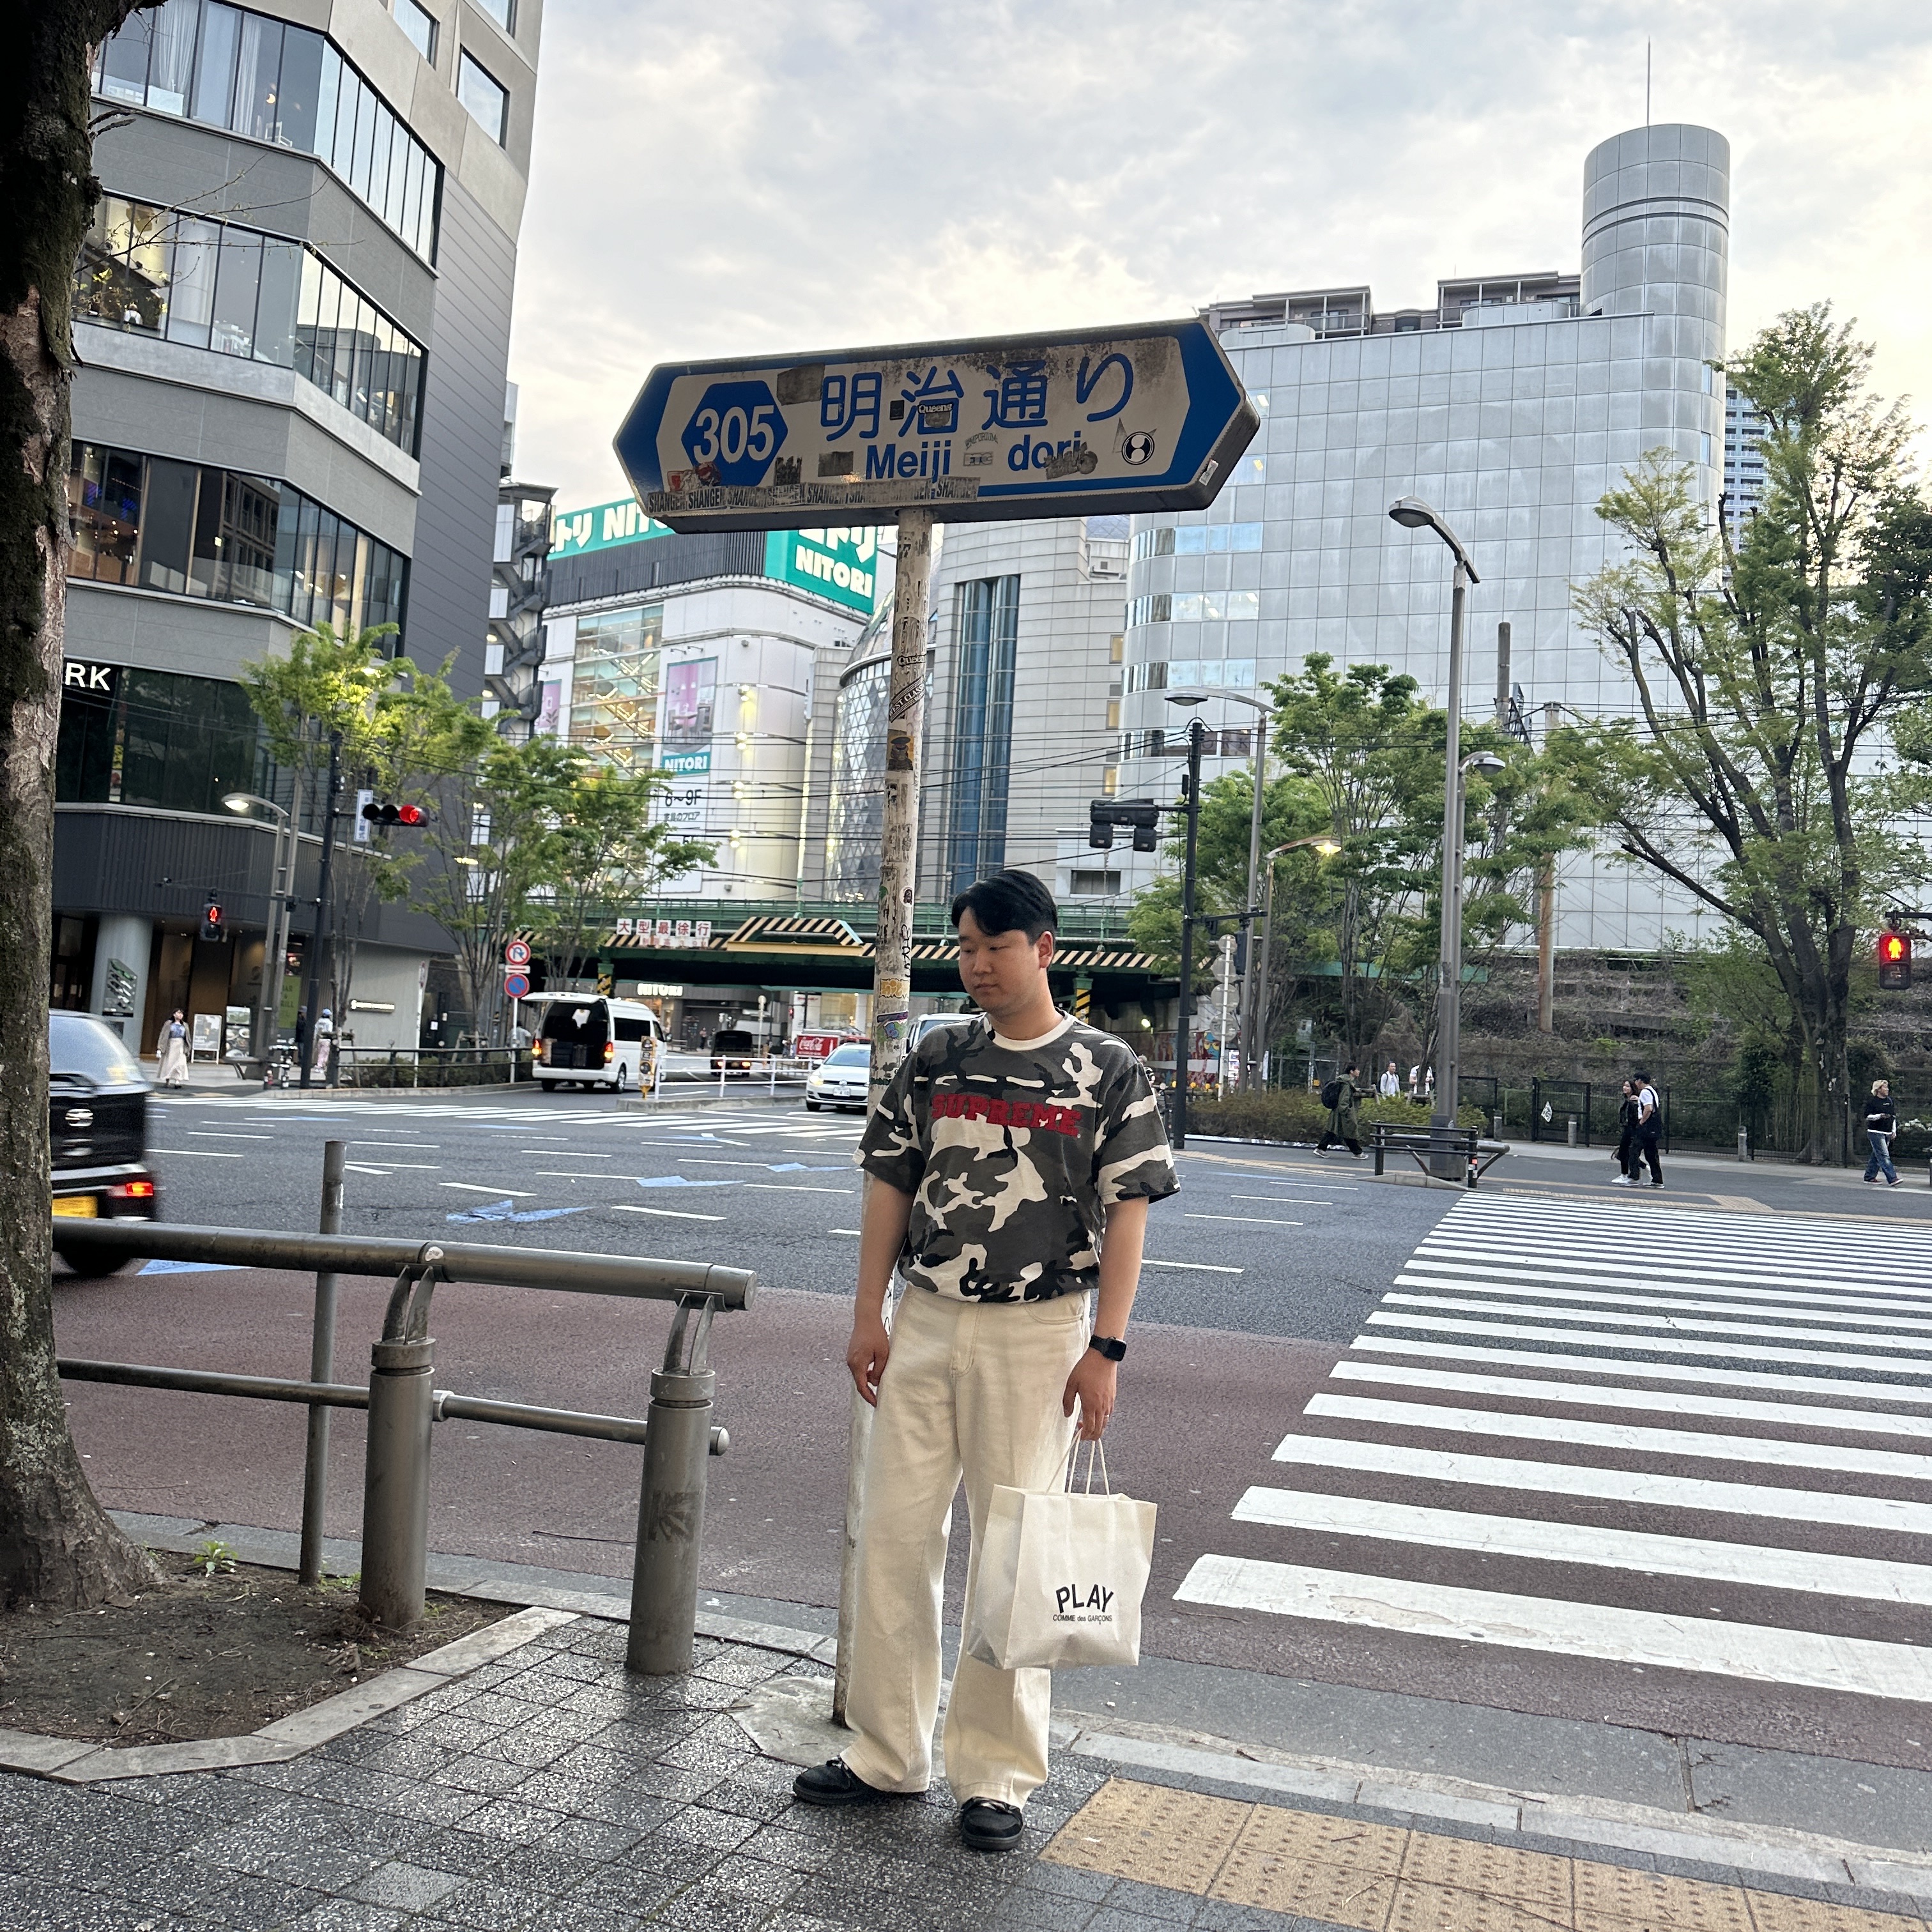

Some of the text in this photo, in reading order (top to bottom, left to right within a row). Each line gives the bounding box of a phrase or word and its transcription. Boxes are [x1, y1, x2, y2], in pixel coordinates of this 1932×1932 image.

[820, 352, 1133, 440] 明治通り
[918, 402, 953, 414] Queens
[693, 404, 774, 463] 305
[865, 440, 951, 484] Meiji
[795, 544, 873, 599] NITORI
[664, 755, 707, 771] NITORI
[618, 920, 709, 937] 大型最徐行
[931, 1093, 1082, 1138] SUPREME
[1055, 1583, 1114, 1614] PLAY
[1087, 1614, 1113, 1625] GARÇONS
